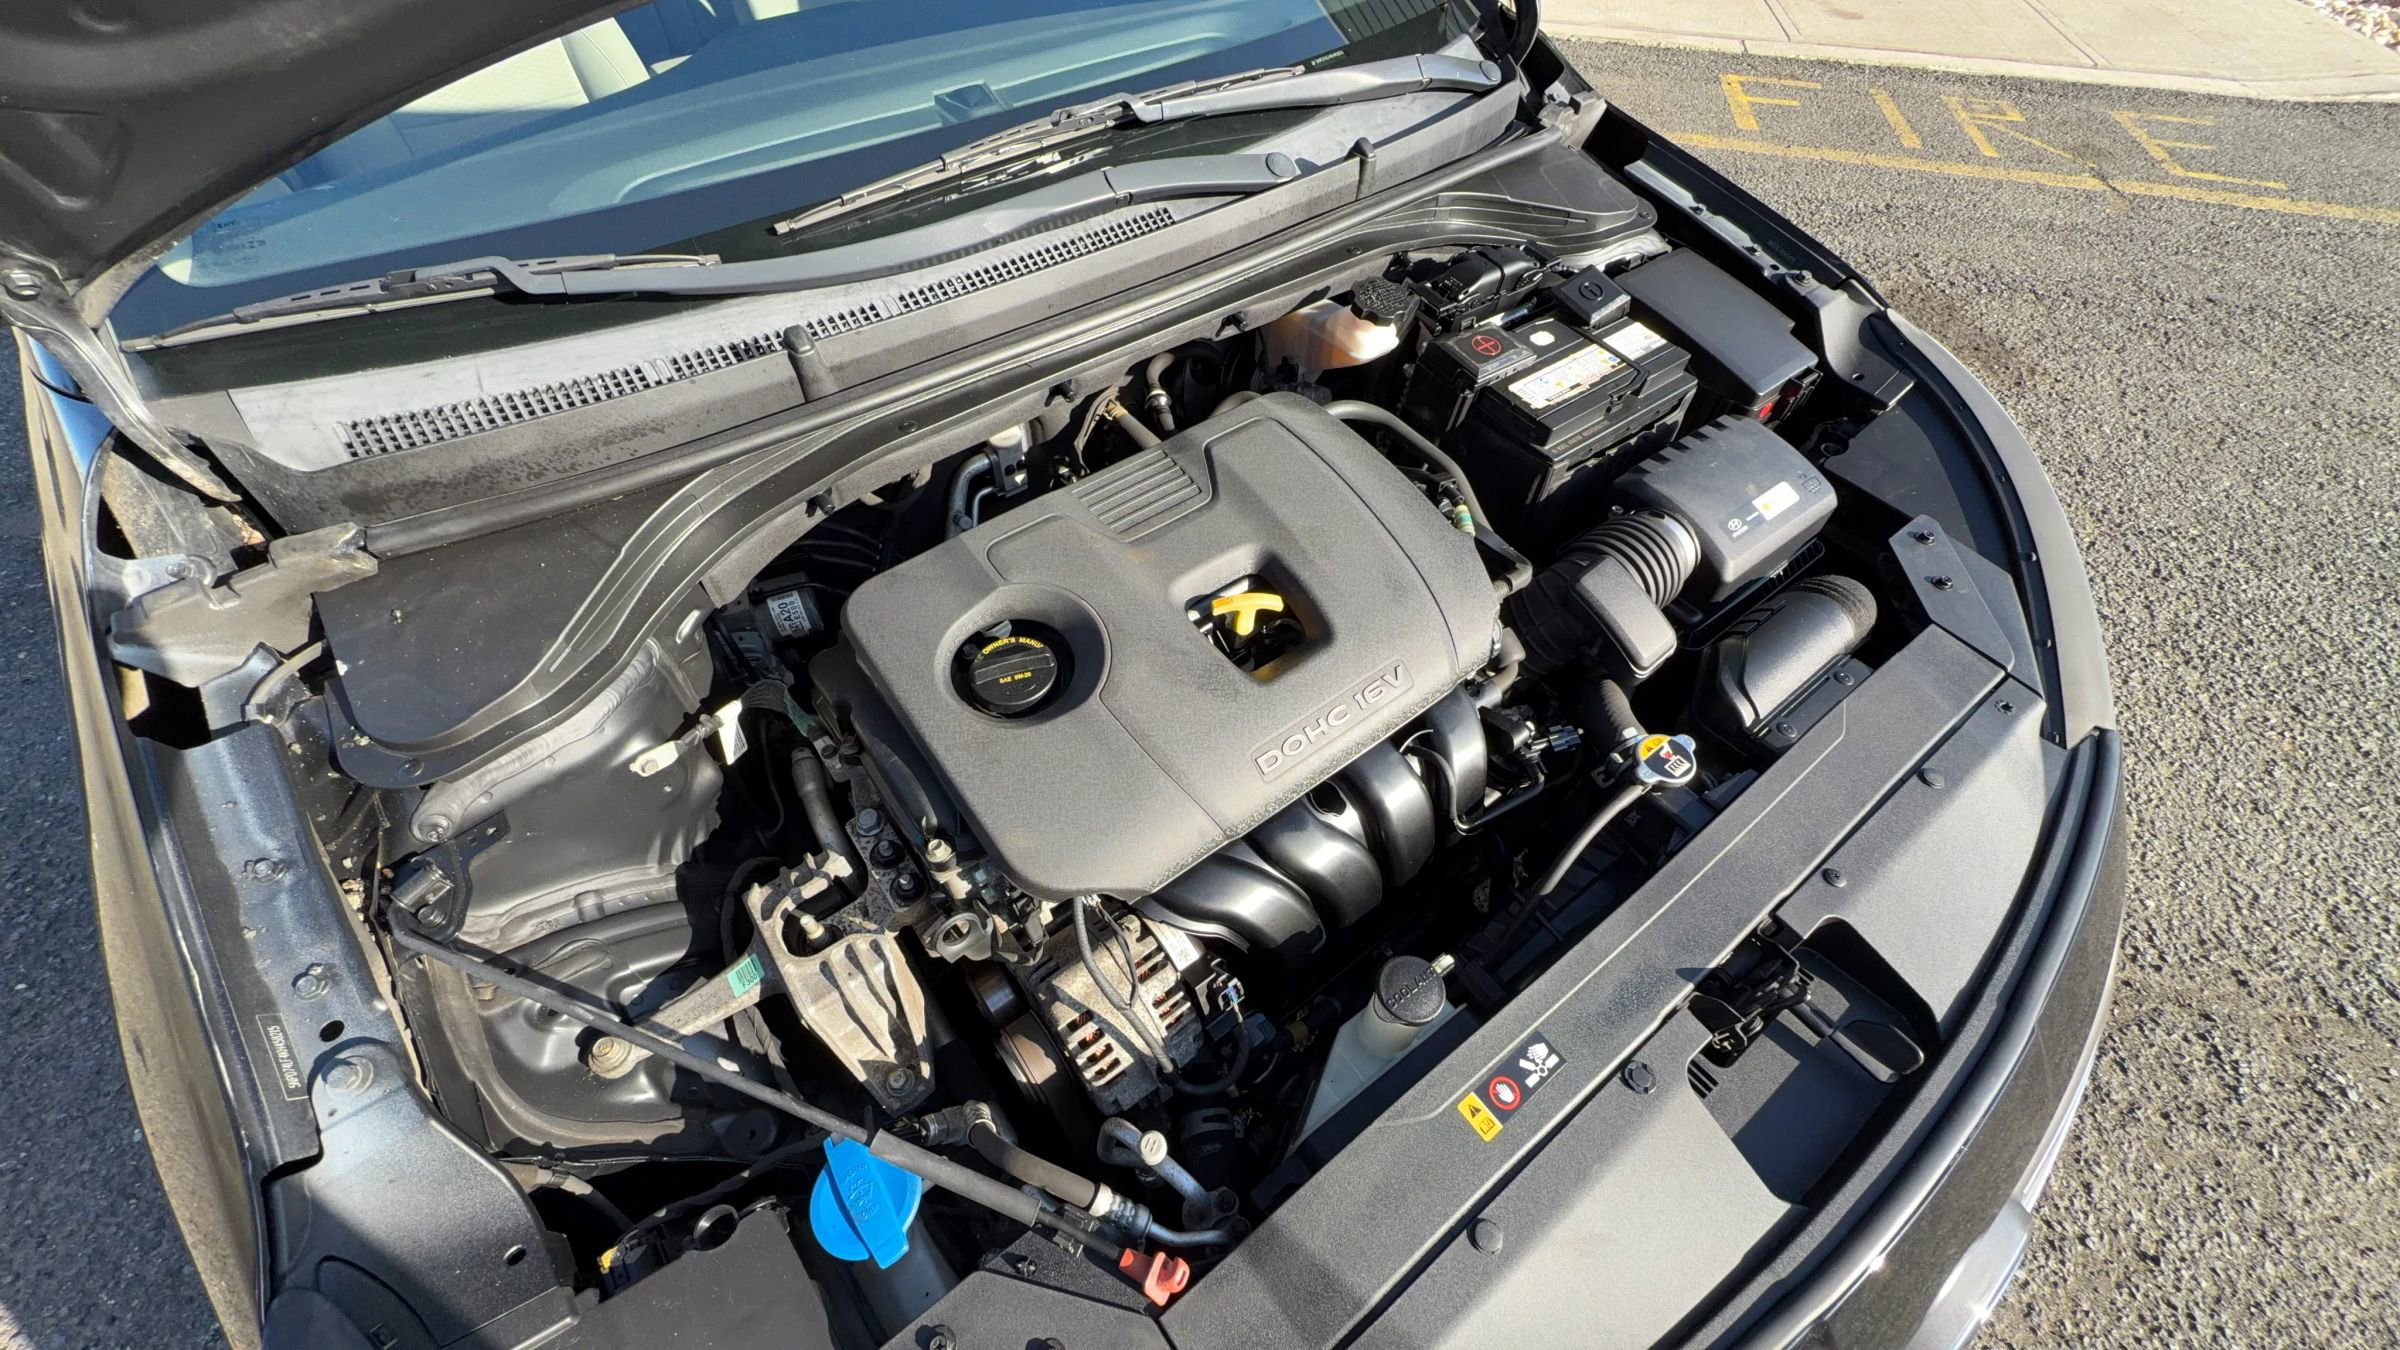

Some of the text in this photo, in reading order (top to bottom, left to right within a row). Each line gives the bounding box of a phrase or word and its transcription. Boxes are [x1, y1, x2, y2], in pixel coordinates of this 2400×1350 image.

[1720, 73, 2290, 189] FIRE
[982, 637, 1016, 655] OWNER'S
[1018, 637, 1044, 649] MANU
[1255, 664, 1402, 775] DOHC 16V
[1385, 966, 1438, 1009] COOLANT
